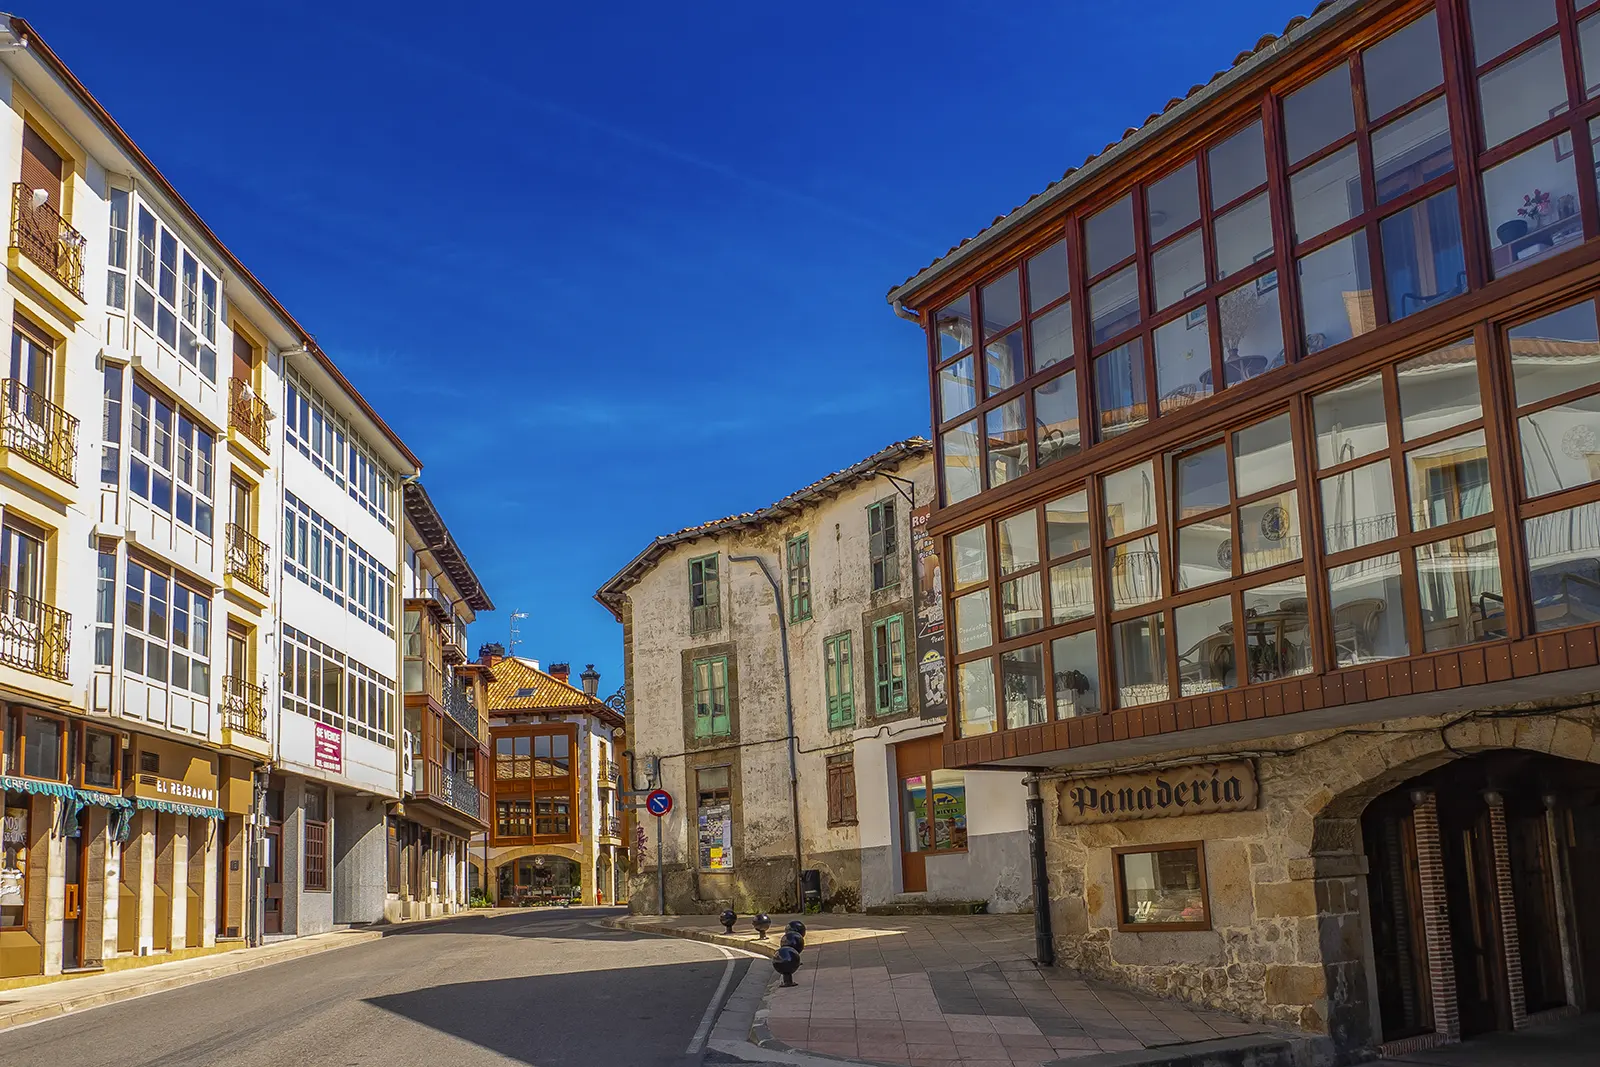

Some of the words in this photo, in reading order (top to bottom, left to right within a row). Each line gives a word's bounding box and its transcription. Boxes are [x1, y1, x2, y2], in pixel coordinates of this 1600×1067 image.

[317, 727, 324, 738] SE
[324, 730, 341, 743] VENDE
[157, 780, 167, 793] EL
[171, 782, 213, 802] RESBALON
[1069, 769, 1244, 815] Panadería
